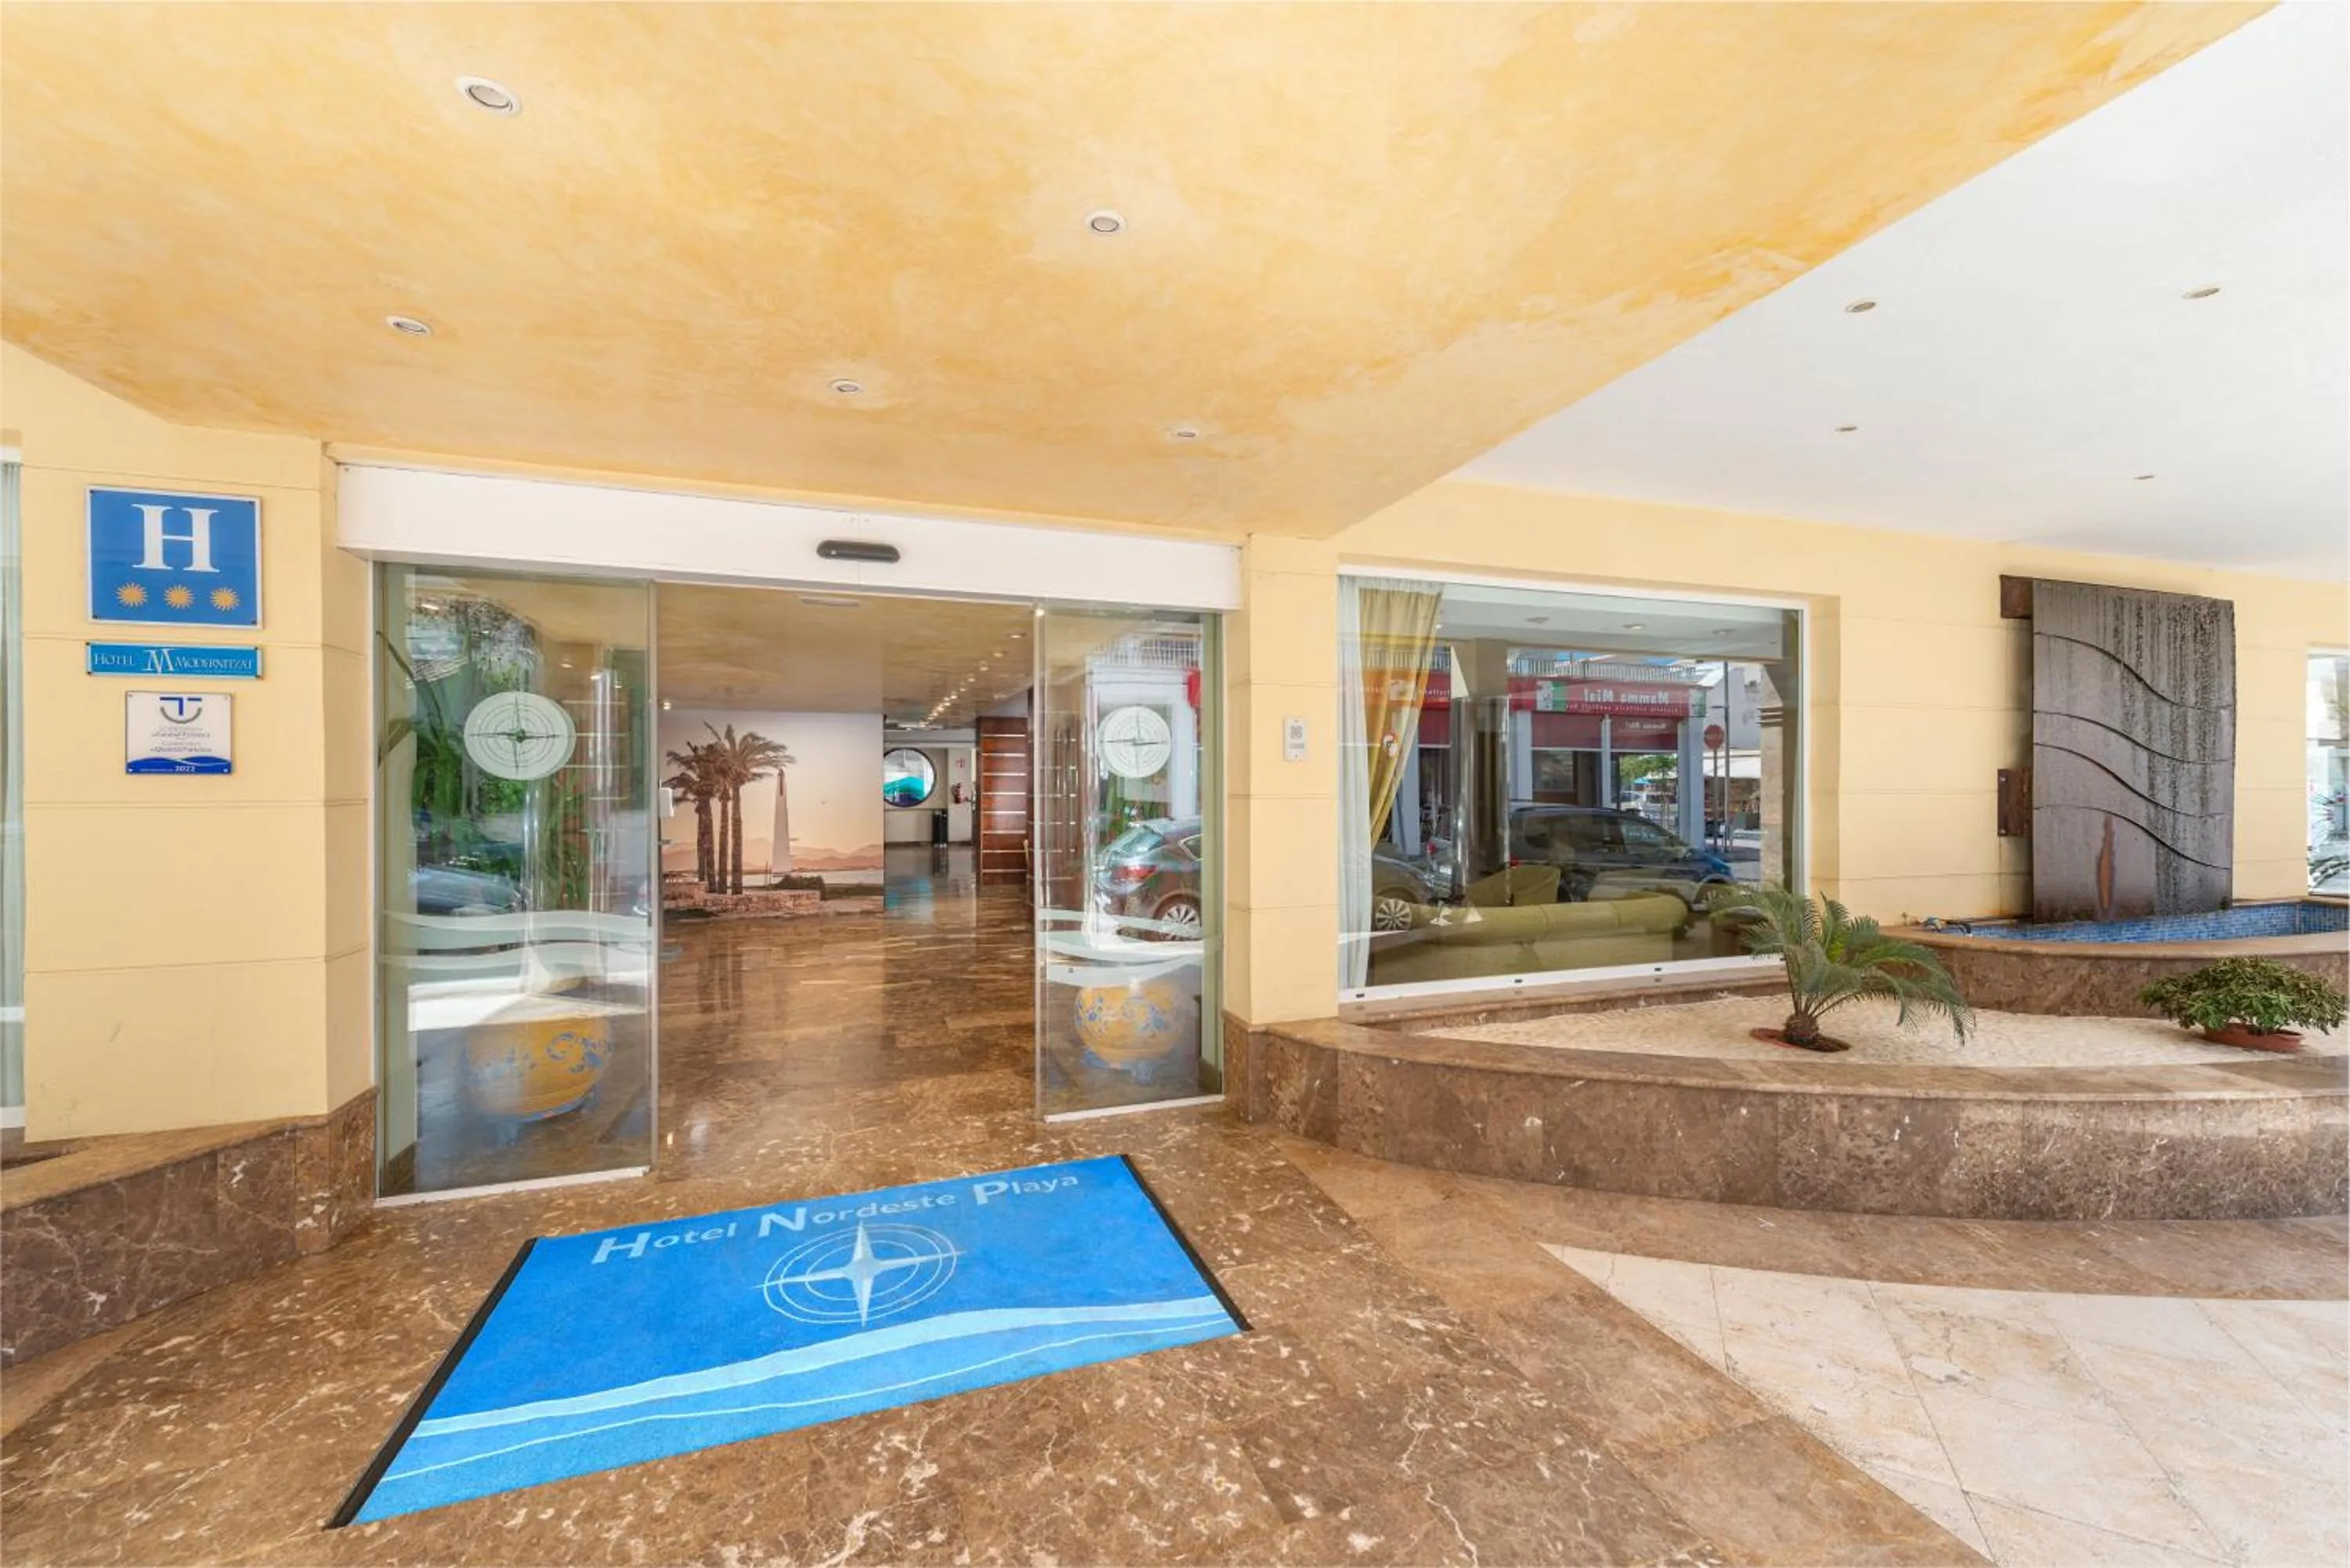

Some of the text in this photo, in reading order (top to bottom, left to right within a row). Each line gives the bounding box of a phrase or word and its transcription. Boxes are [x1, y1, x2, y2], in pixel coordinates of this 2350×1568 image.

[132, 504, 220, 573] H
[591, 1175, 1079, 1265] Hotel Nordeste Playa
